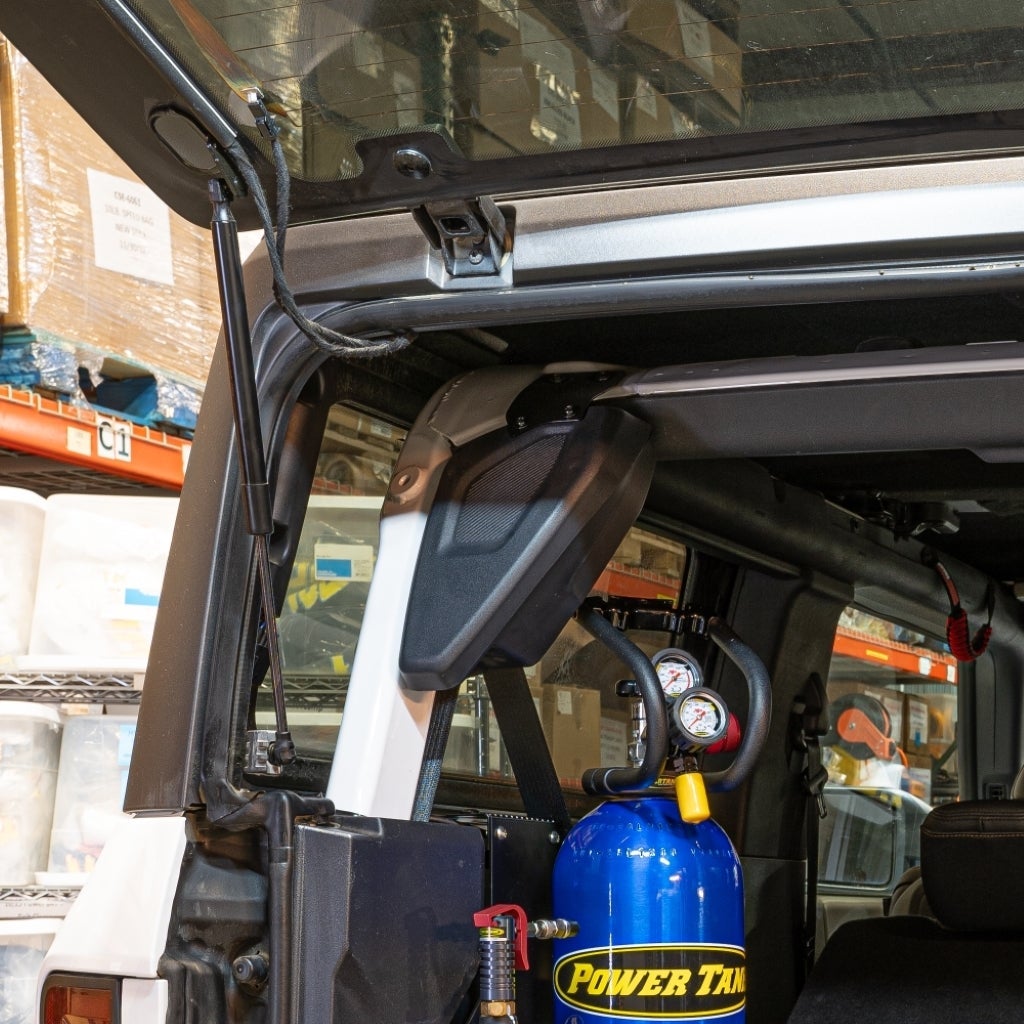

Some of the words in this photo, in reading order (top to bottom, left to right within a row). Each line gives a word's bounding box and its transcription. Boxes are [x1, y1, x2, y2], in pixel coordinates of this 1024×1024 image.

[99, 421, 129, 457] C1
[567, 962, 692, 996] POWER
[695, 963, 746, 996] TAN
